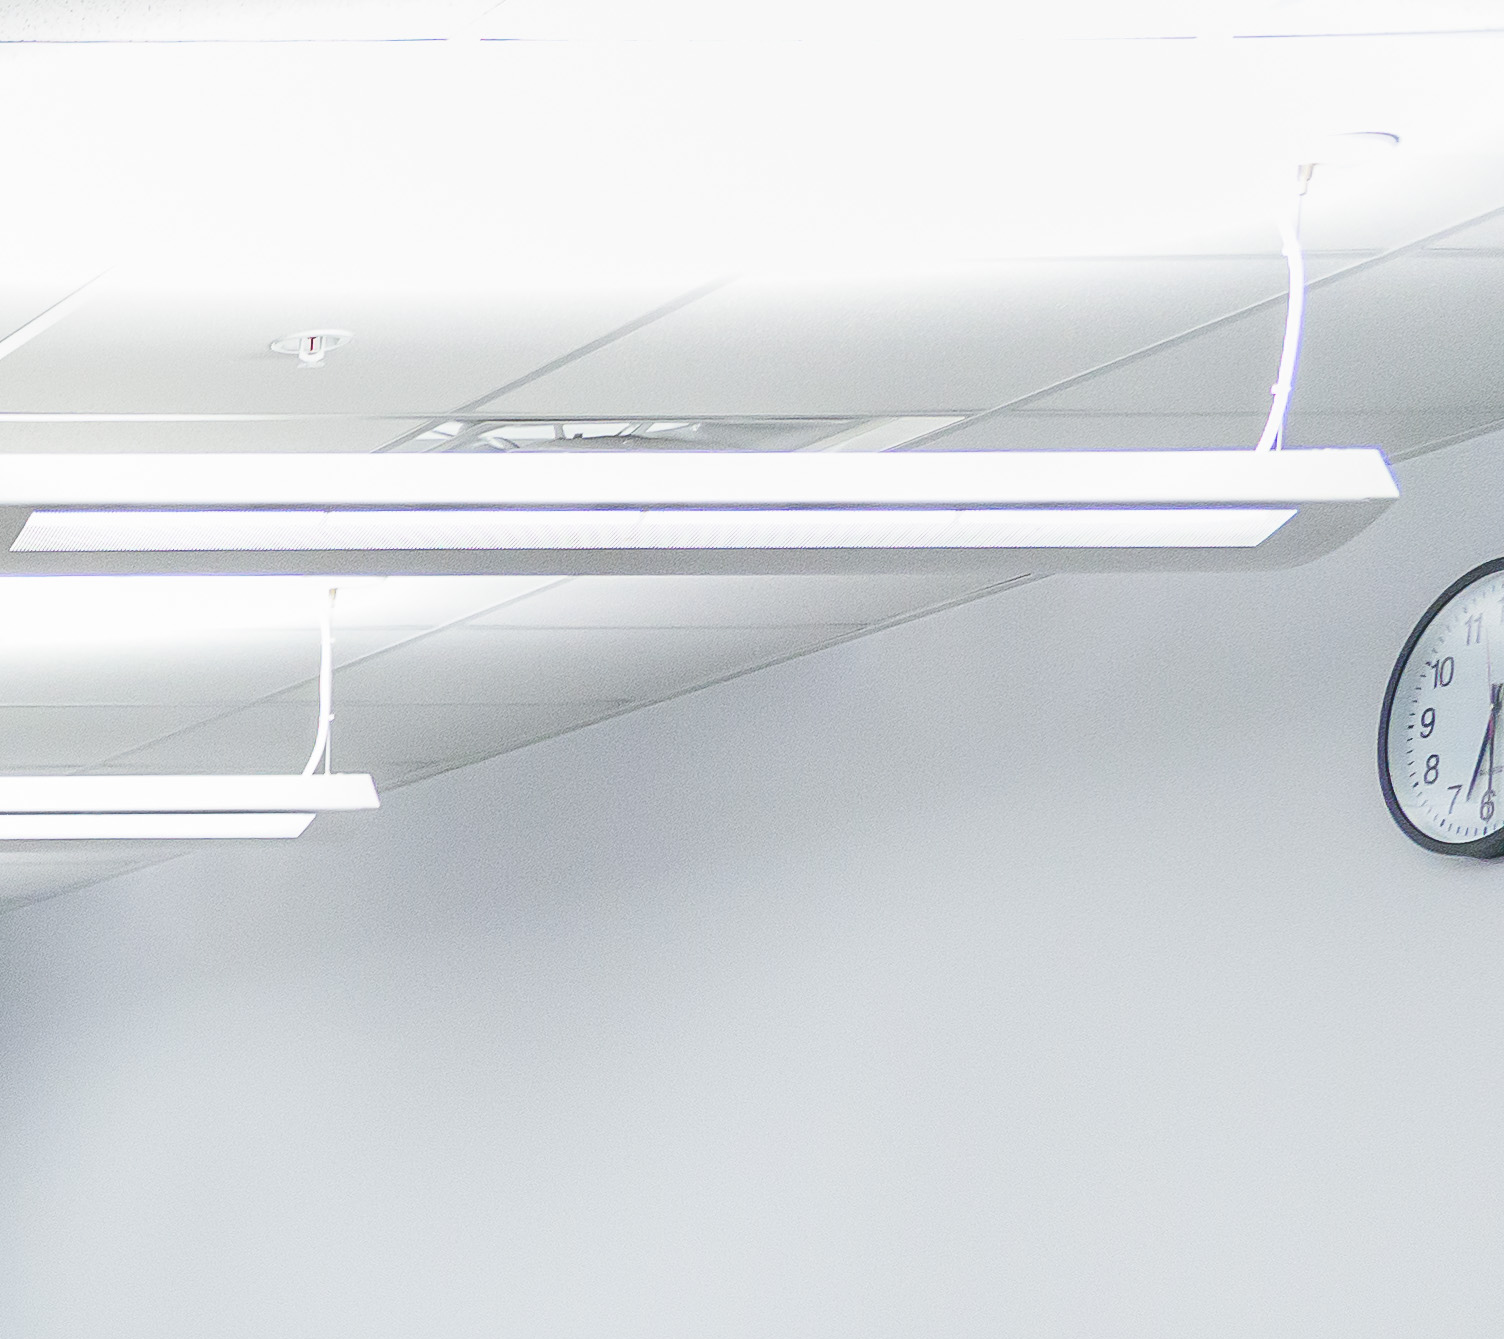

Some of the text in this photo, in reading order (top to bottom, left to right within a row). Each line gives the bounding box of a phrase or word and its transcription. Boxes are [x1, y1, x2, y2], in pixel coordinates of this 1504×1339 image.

[1464, 613, 1483, 646] 11
[1431, 656, 1454, 689] 10
[1420, 707, 1436, 738] 9
[1423, 754, 1440, 784] 8
[1446, 784, 1463, 815] 7
[1479, 789, 1495, 822] 6
